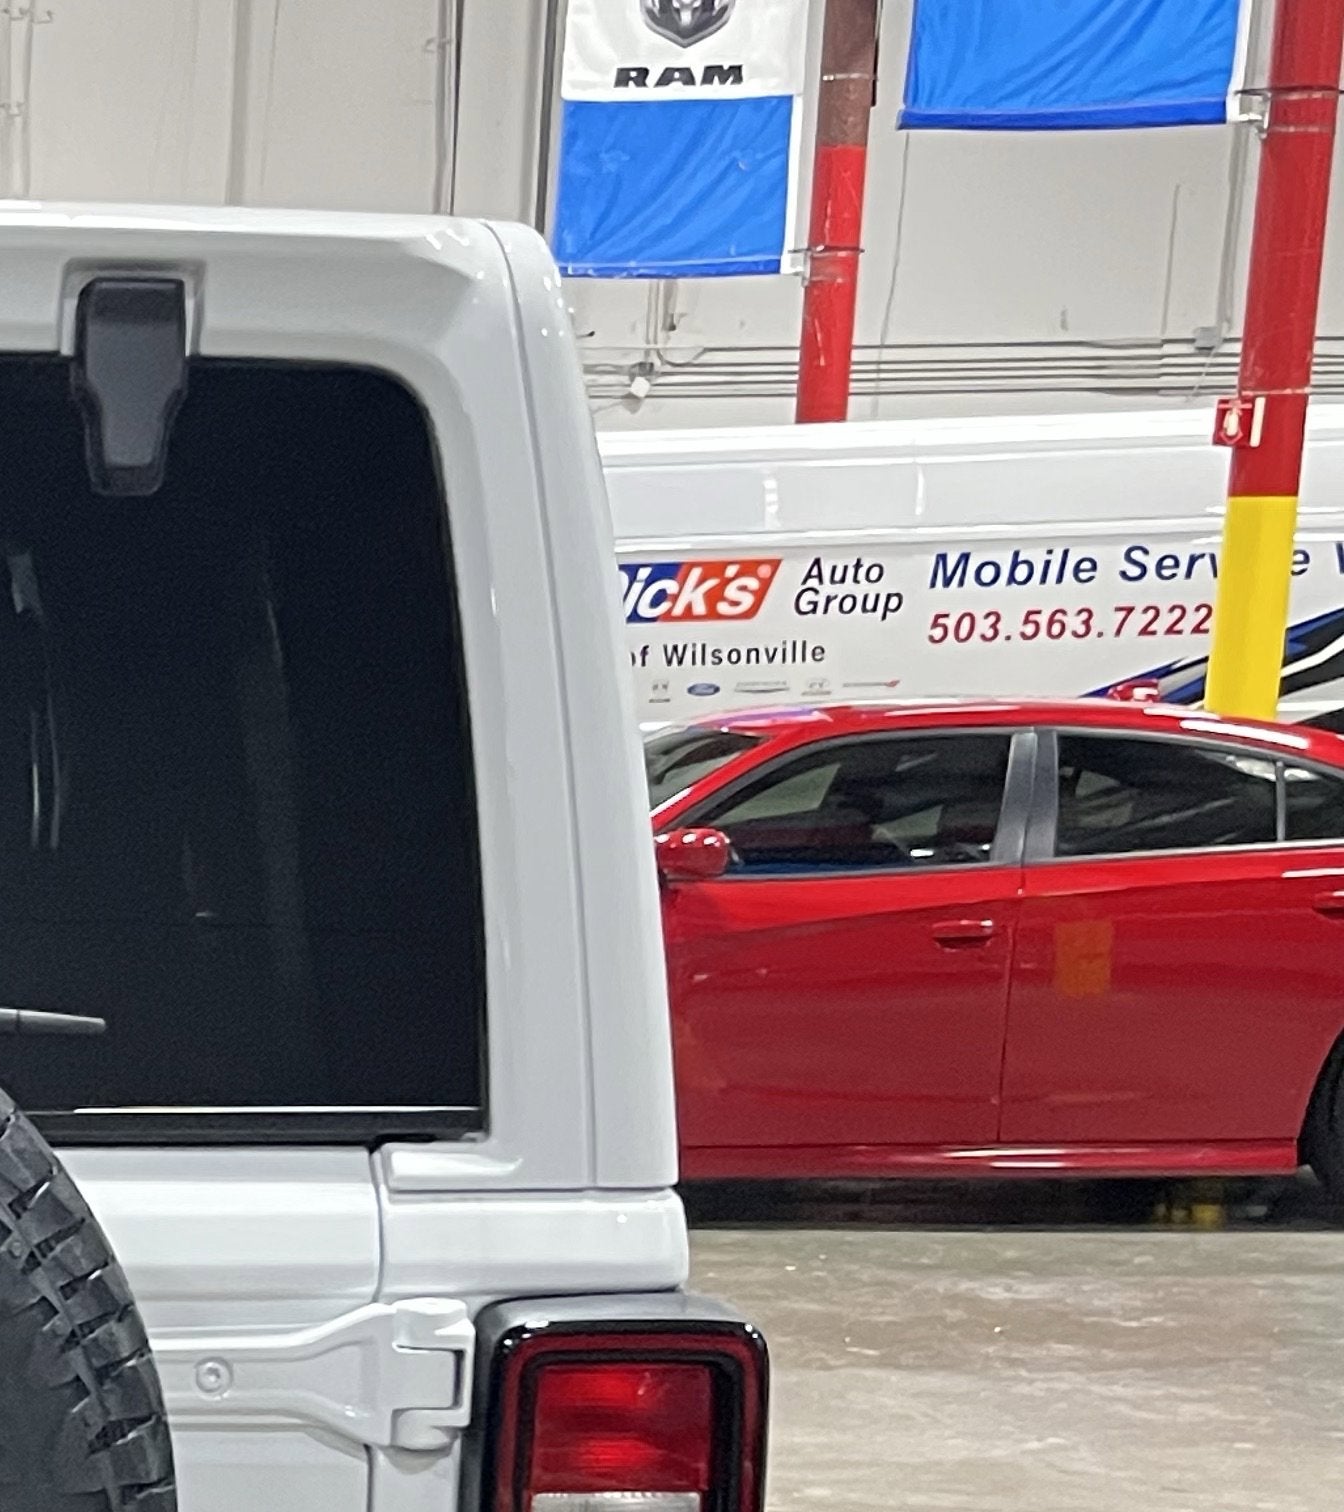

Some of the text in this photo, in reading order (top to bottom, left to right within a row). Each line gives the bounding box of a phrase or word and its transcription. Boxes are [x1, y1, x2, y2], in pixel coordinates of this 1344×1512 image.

[614, 64, 743, 88] RAM
[800, 557, 885, 586] Auto
[929, 547, 1099, 589] Mobile
[1119, 544, 1310, 583] Sere
[620, 563, 762, 618] ick's
[794, 586, 904, 621] Group
[928, 602, 1213, 645] 503.563.7222
[631, 640, 826, 667] f Wilsonville
